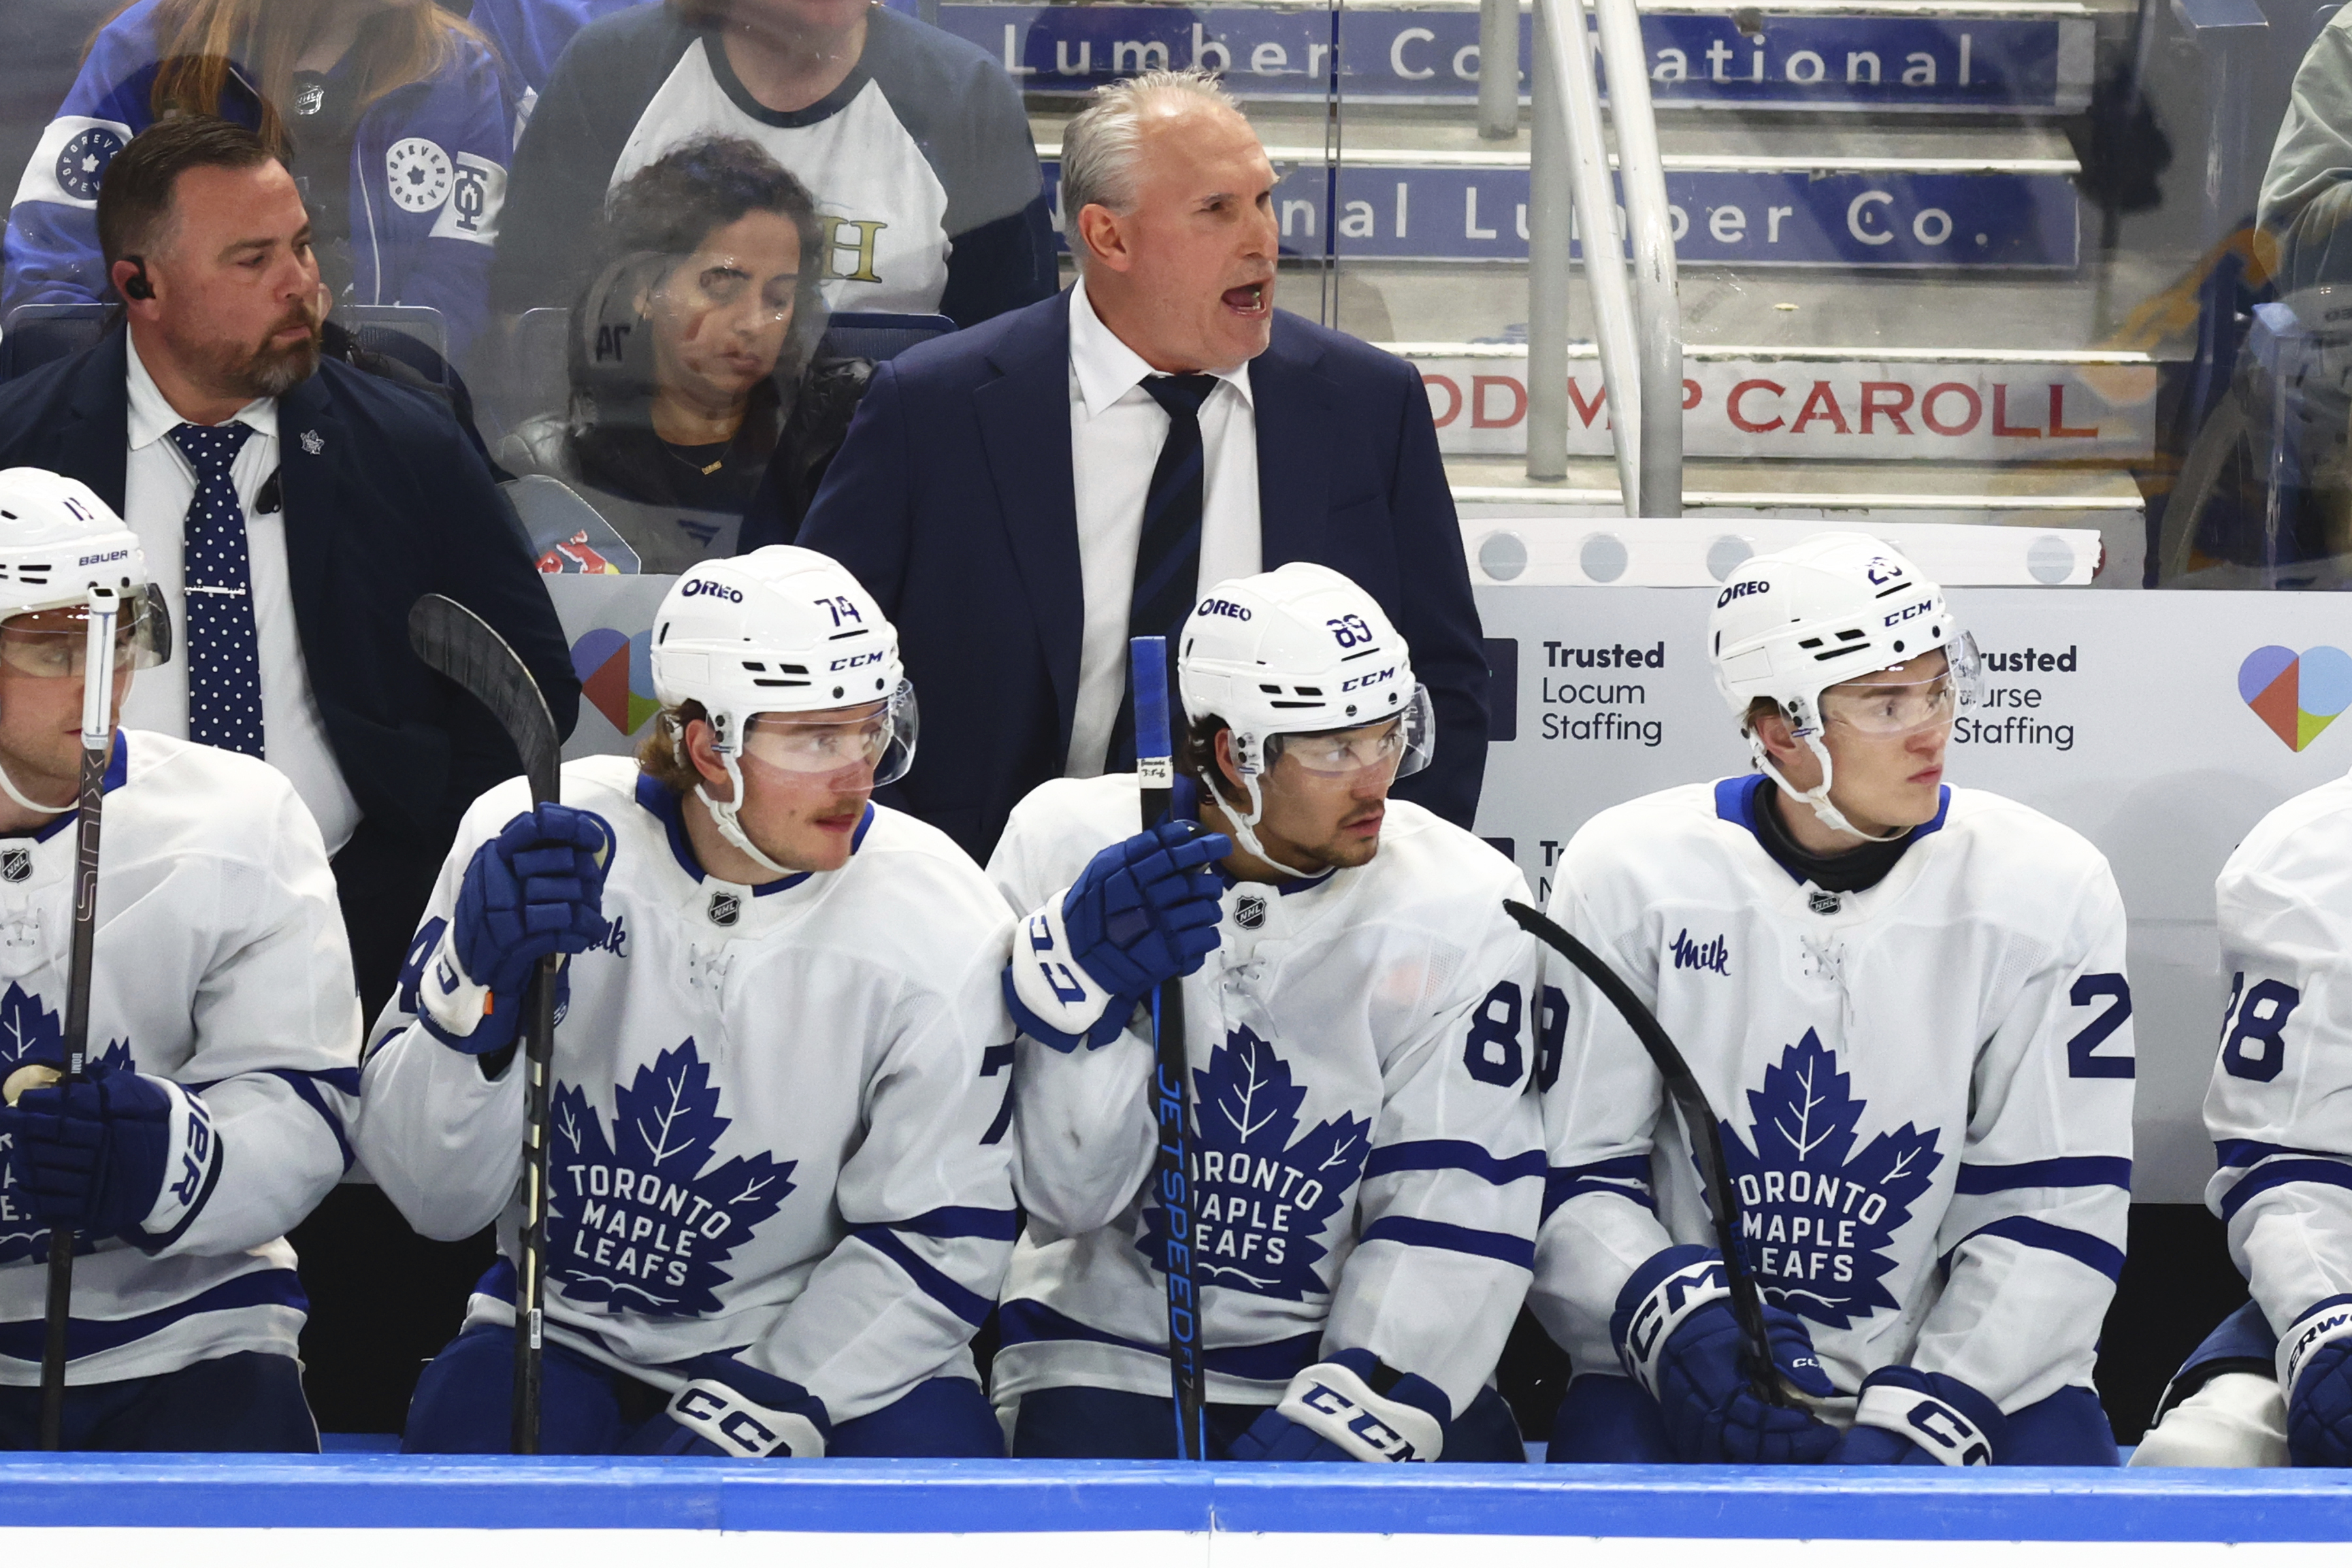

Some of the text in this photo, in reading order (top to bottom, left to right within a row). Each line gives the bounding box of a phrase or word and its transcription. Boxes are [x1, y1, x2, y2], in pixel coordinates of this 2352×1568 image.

[1004, 23, 1329, 78] Lumber
[1586, 32, 1971, 86] ational
[1847, 191, 1988, 248] Co.
[1727, 378, 2099, 440] CAROLL
[681, 578, 743, 604] OREO
[1716, 580, 1771, 609] OREO
[813, 595, 862, 627] 74
[1197, 598, 1252, 622] OREO
[1883, 599, 1932, 627] CCM
[1326, 613, 1373, 649] 89
[829, 650, 884, 672] CCM
[1543, 640, 1665, 669] Trusted
[1980, 645, 2077, 672] usted
[1341, 666, 1396, 693] CCM
[1543, 677, 1645, 704] Locum
[1982, 688, 2042, 708] urse
[1542, 711, 1663, 747] Staffing
[1953, 716, 2074, 751] Staffing
[7, 856, 25, 877] NHL
[713, 903, 735, 918] NHL
[1240, 905, 1261, 922] NHL
[1669, 928, 1732, 977] Milk
[1463, 980, 1536, 1096] 8
[1191, 1151, 1323, 1211] RONTO
[1729, 1170, 1887, 1226] ORONTO
[566, 1164, 732, 1240] TORONTO
[1158, 1062, 1195, 1344] JETSPEED
[1194, 1189, 1292, 1233] APLE
[581, 1198, 698, 1258] MAPLE
[1196, 1223, 1286, 1265] EAFS
[1742, 1211, 1857, 1249] MAPLE
[573, 1229, 688, 1287] LEAFS
[1751, 1247, 1854, 1282] EAFS
[1626, 1264, 1731, 1395] CM
[676, 1388, 792, 1458] CC
